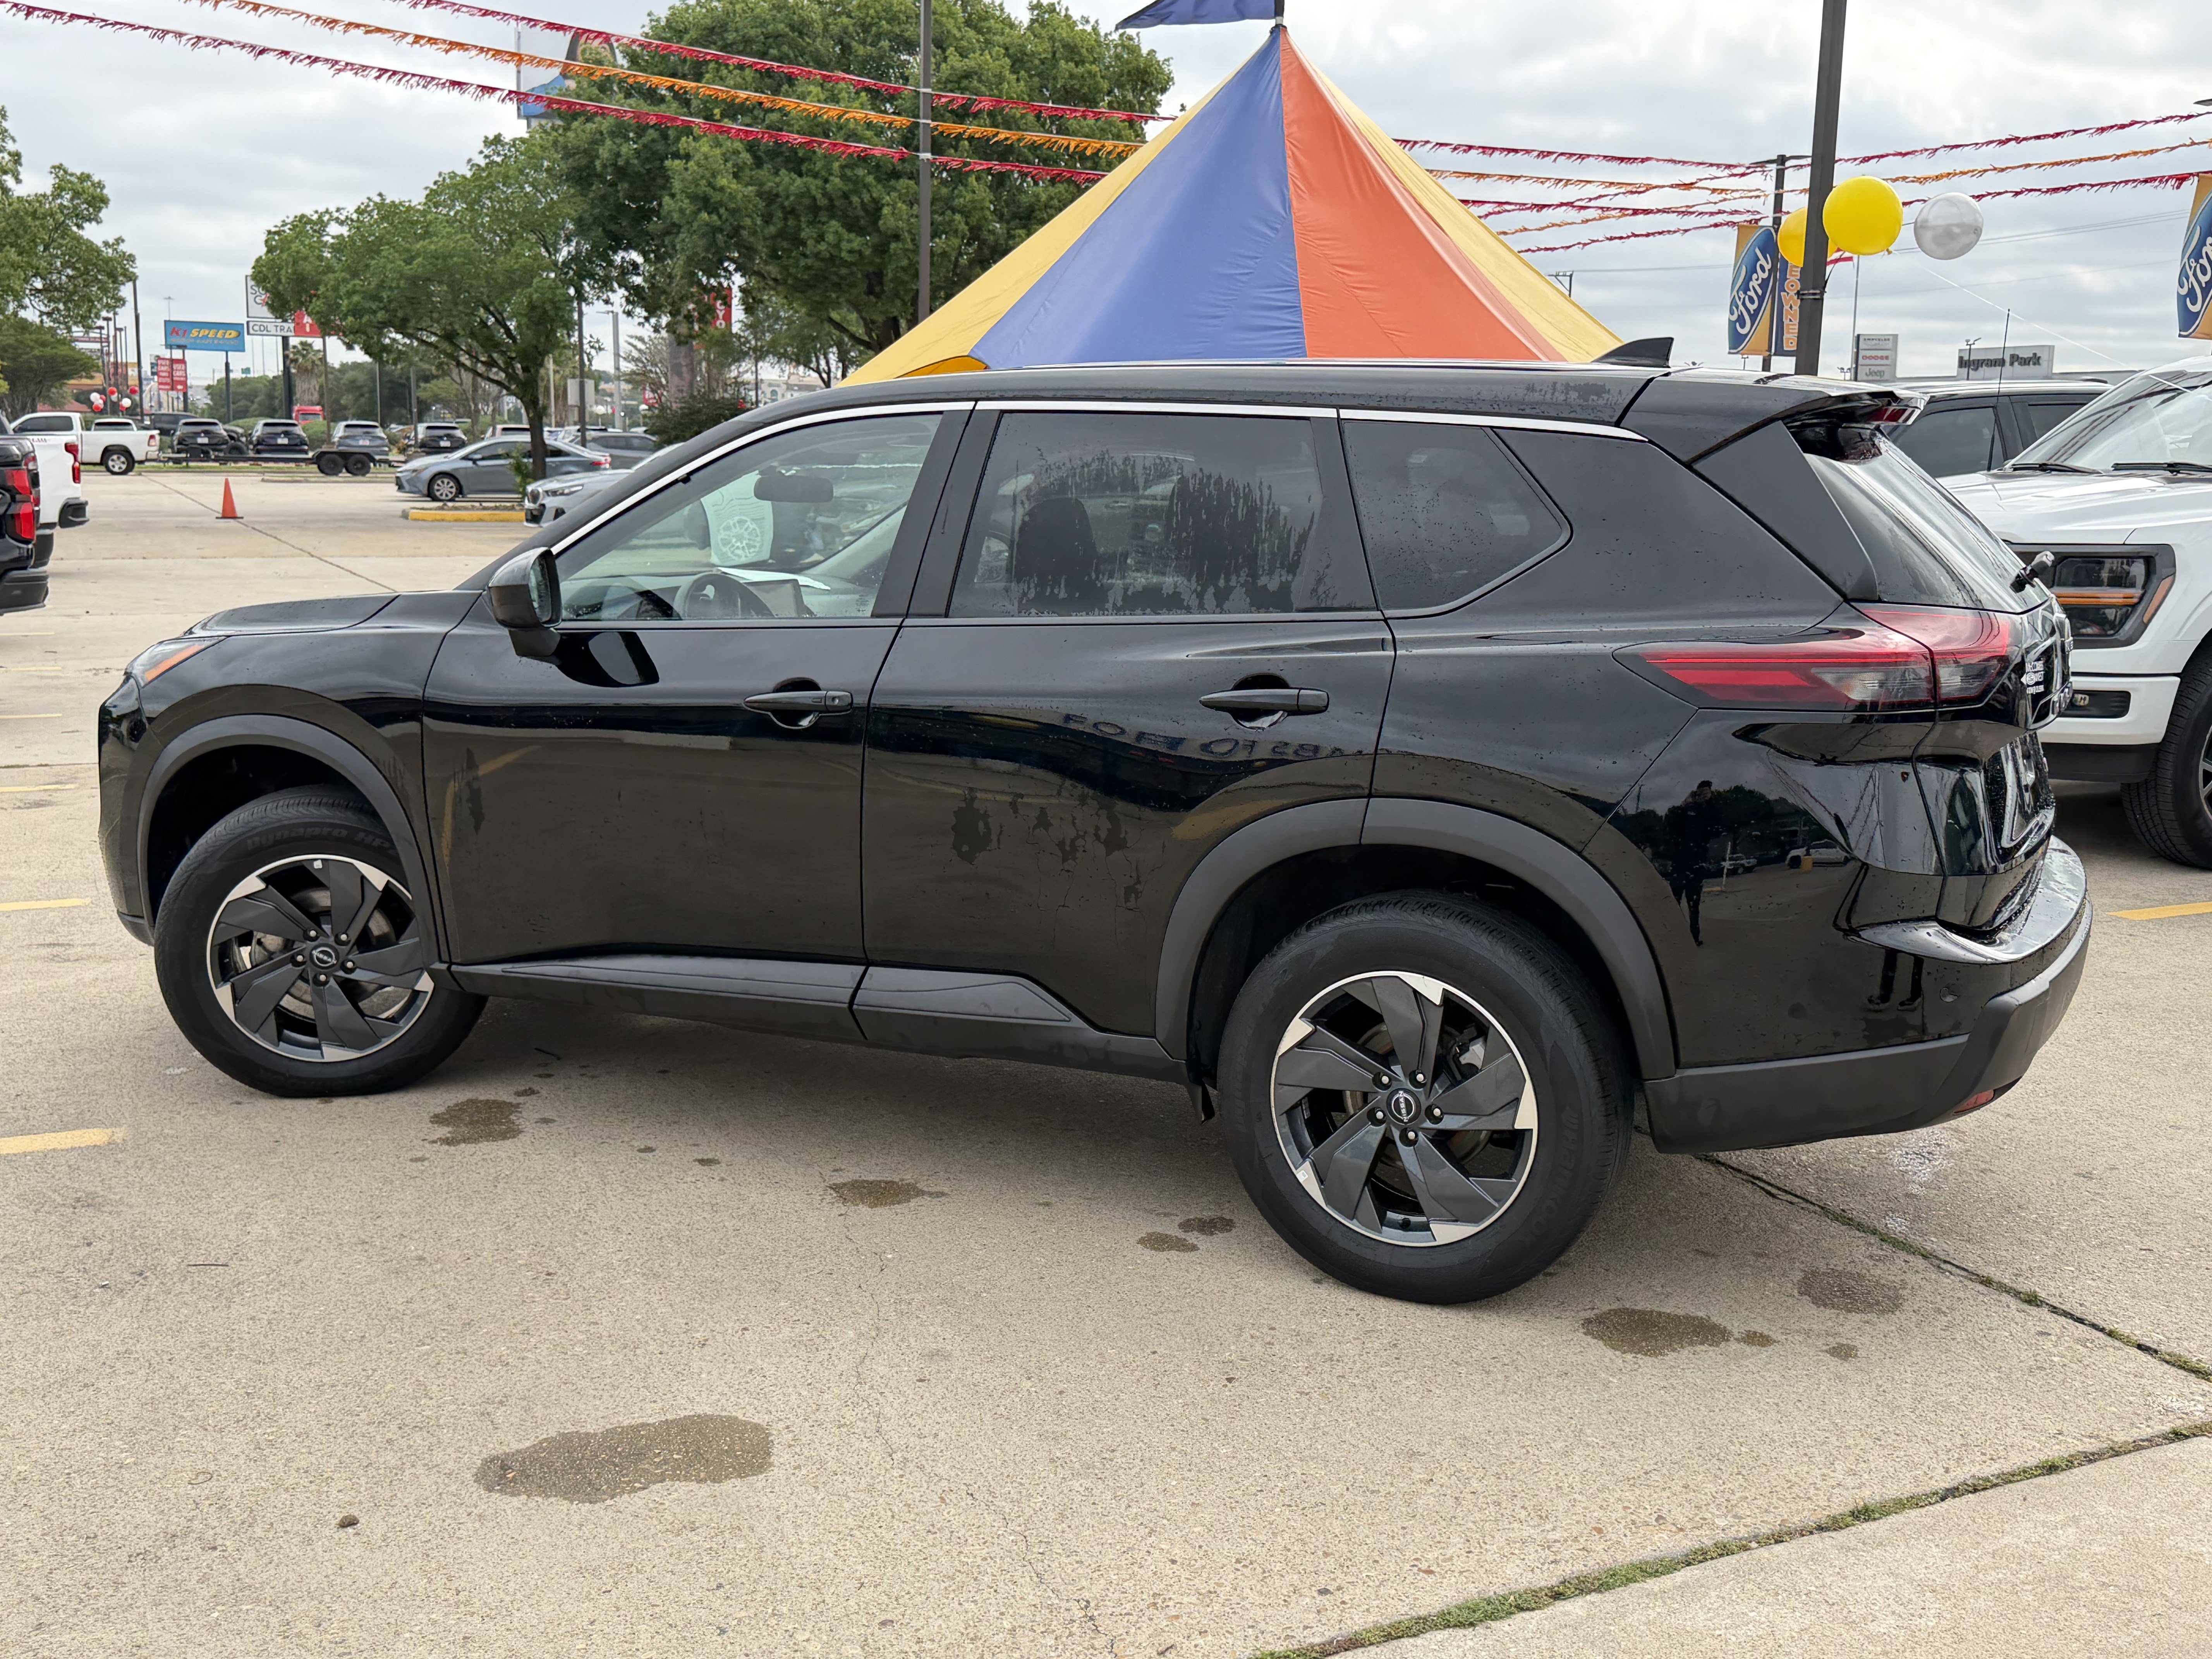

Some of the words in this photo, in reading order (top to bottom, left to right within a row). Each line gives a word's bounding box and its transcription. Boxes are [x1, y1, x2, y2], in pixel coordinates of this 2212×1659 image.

[2178, 226, 2212, 312] For
[1729, 247, 1772, 334] Ford
[170, 327, 187, 338] K1
[190, 329, 241, 339] SPEED
[251, 324, 271, 332] CDL
[1958, 356, 2006, 371] Ingram
[2009, 352, 2041, 366] Park
[1865, 368, 1885, 378] Jeep
[247, 826, 348, 851] Dynapro
[1399, 1091, 1408, 1122] NISSAN
